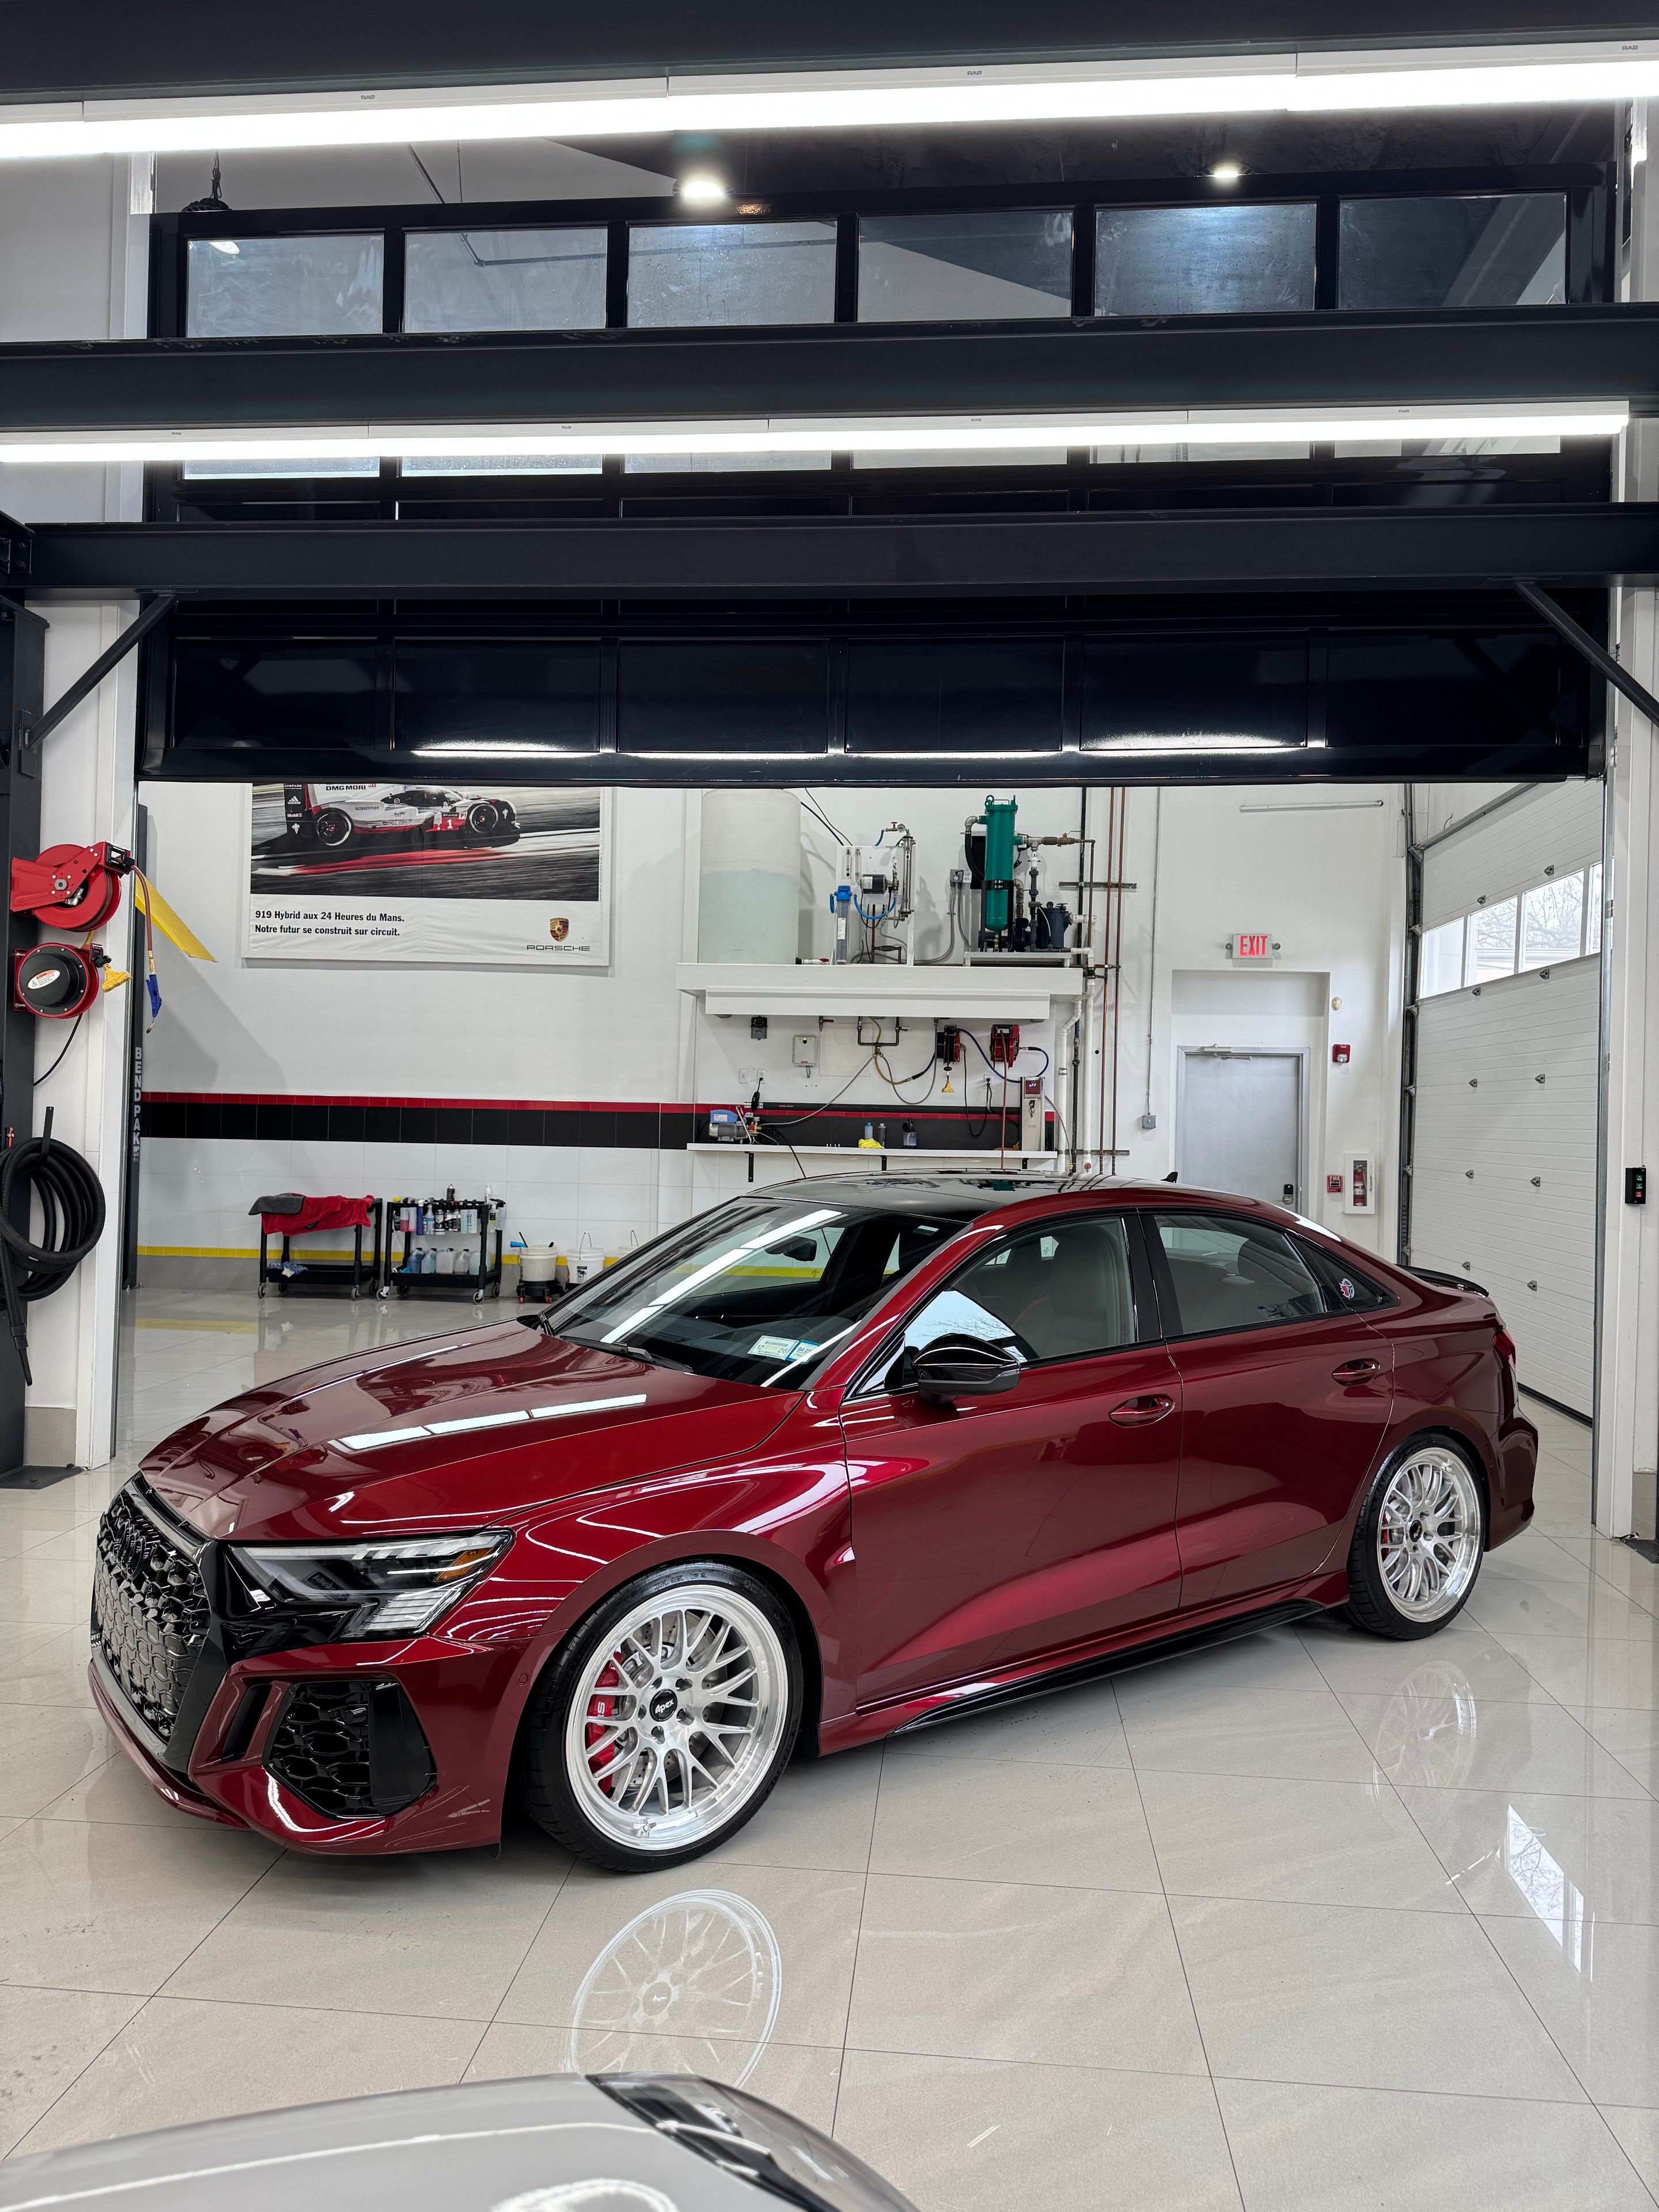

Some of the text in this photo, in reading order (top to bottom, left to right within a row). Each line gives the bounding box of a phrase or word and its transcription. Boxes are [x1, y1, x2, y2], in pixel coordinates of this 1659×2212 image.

[447, 819, 453, 829] 1
[255, 910, 272, 918] 919
[274, 911, 301, 920] Hybrid
[320, 912, 332, 920] 24
[335, 912, 364, 921] Heures
[366, 913, 377, 921] du
[379, 914, 404, 922] Mans.
[255, 925, 278, 933] Notre
[279, 925, 300, 933] futur
[315, 926, 352, 934] construit
[370, 927, 400, 936] circuit.
[1240, 935, 1268, 956] EXIT
[133, 1047, 142, 1145] BENDPAK
[655, 1699, 674, 1714] Apex
